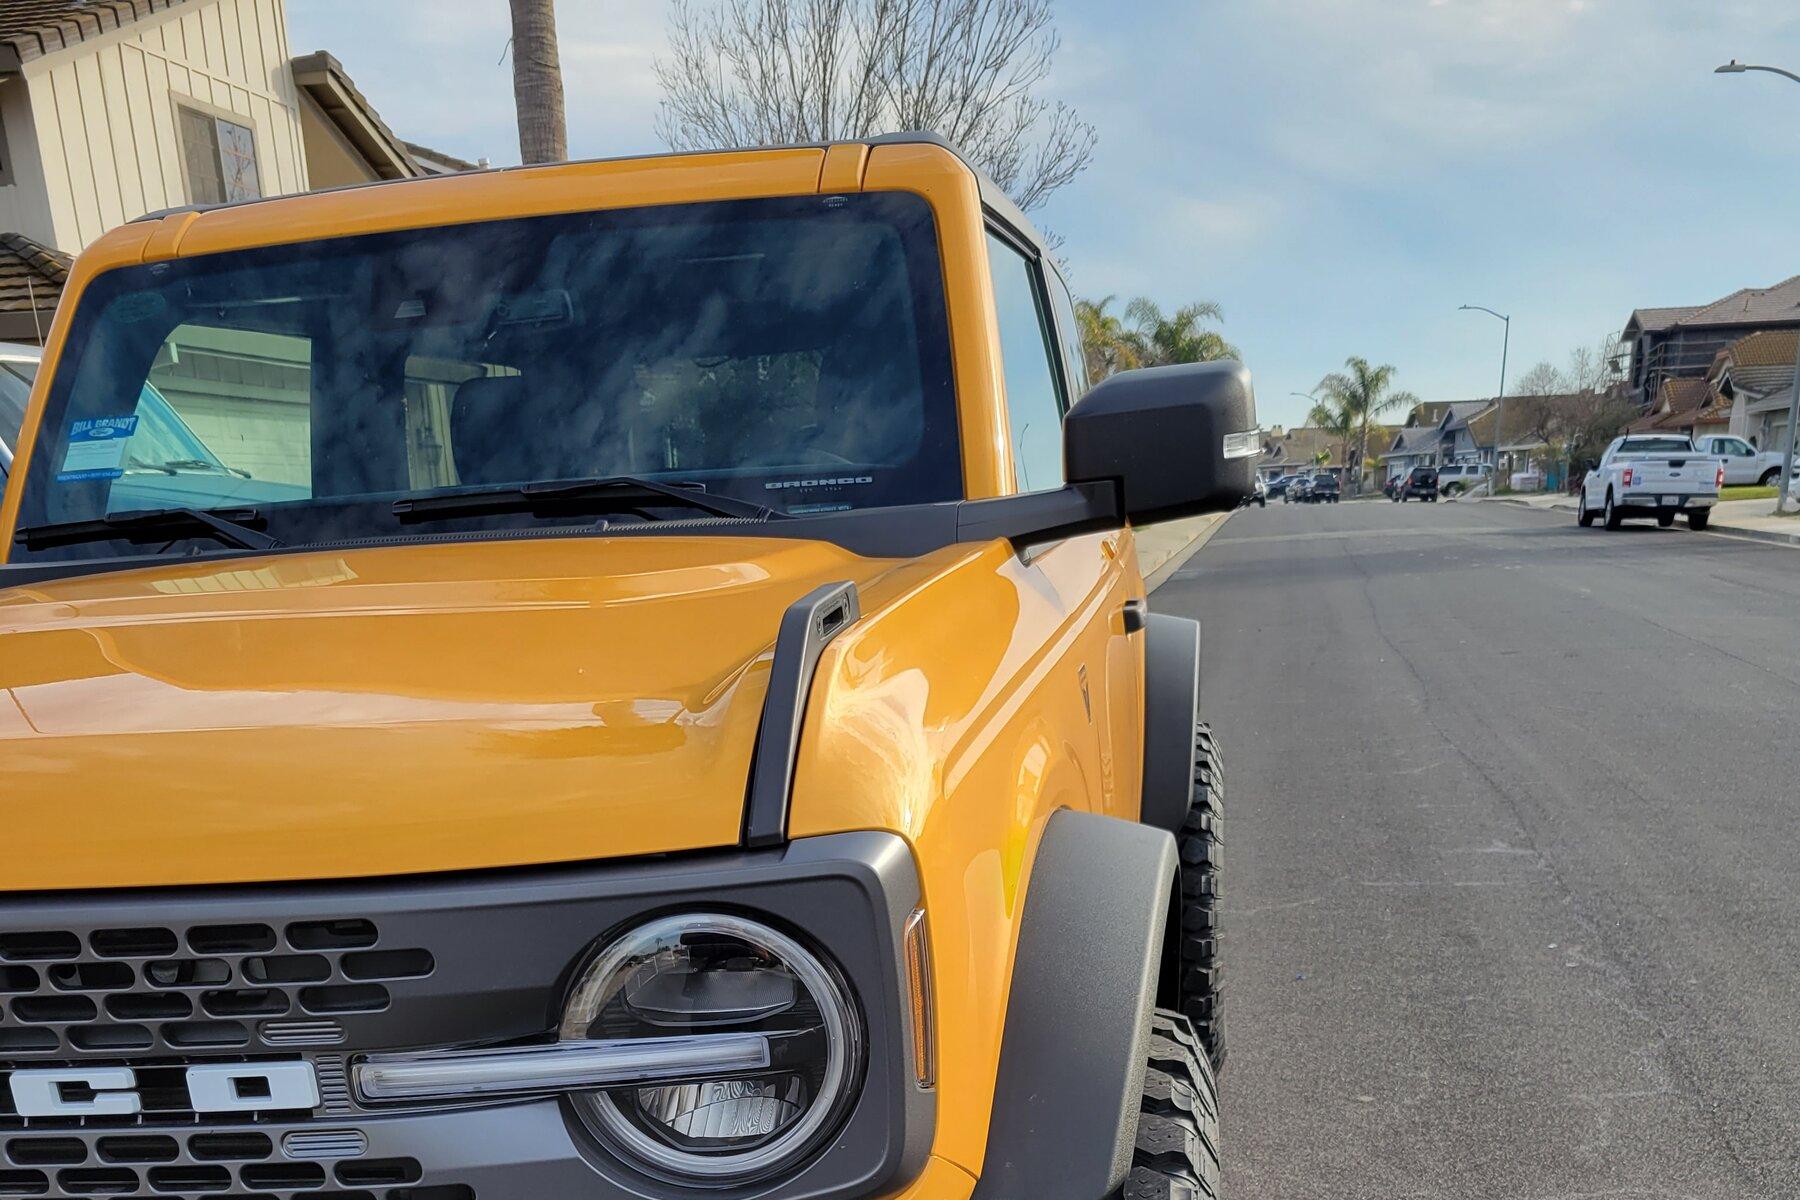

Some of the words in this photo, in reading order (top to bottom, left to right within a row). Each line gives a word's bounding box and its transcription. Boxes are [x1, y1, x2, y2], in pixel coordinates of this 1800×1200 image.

[71, 419, 92, 435] BILL
[95, 417, 136, 431] BRANDT
[765, 476, 873, 490] BRONCO
